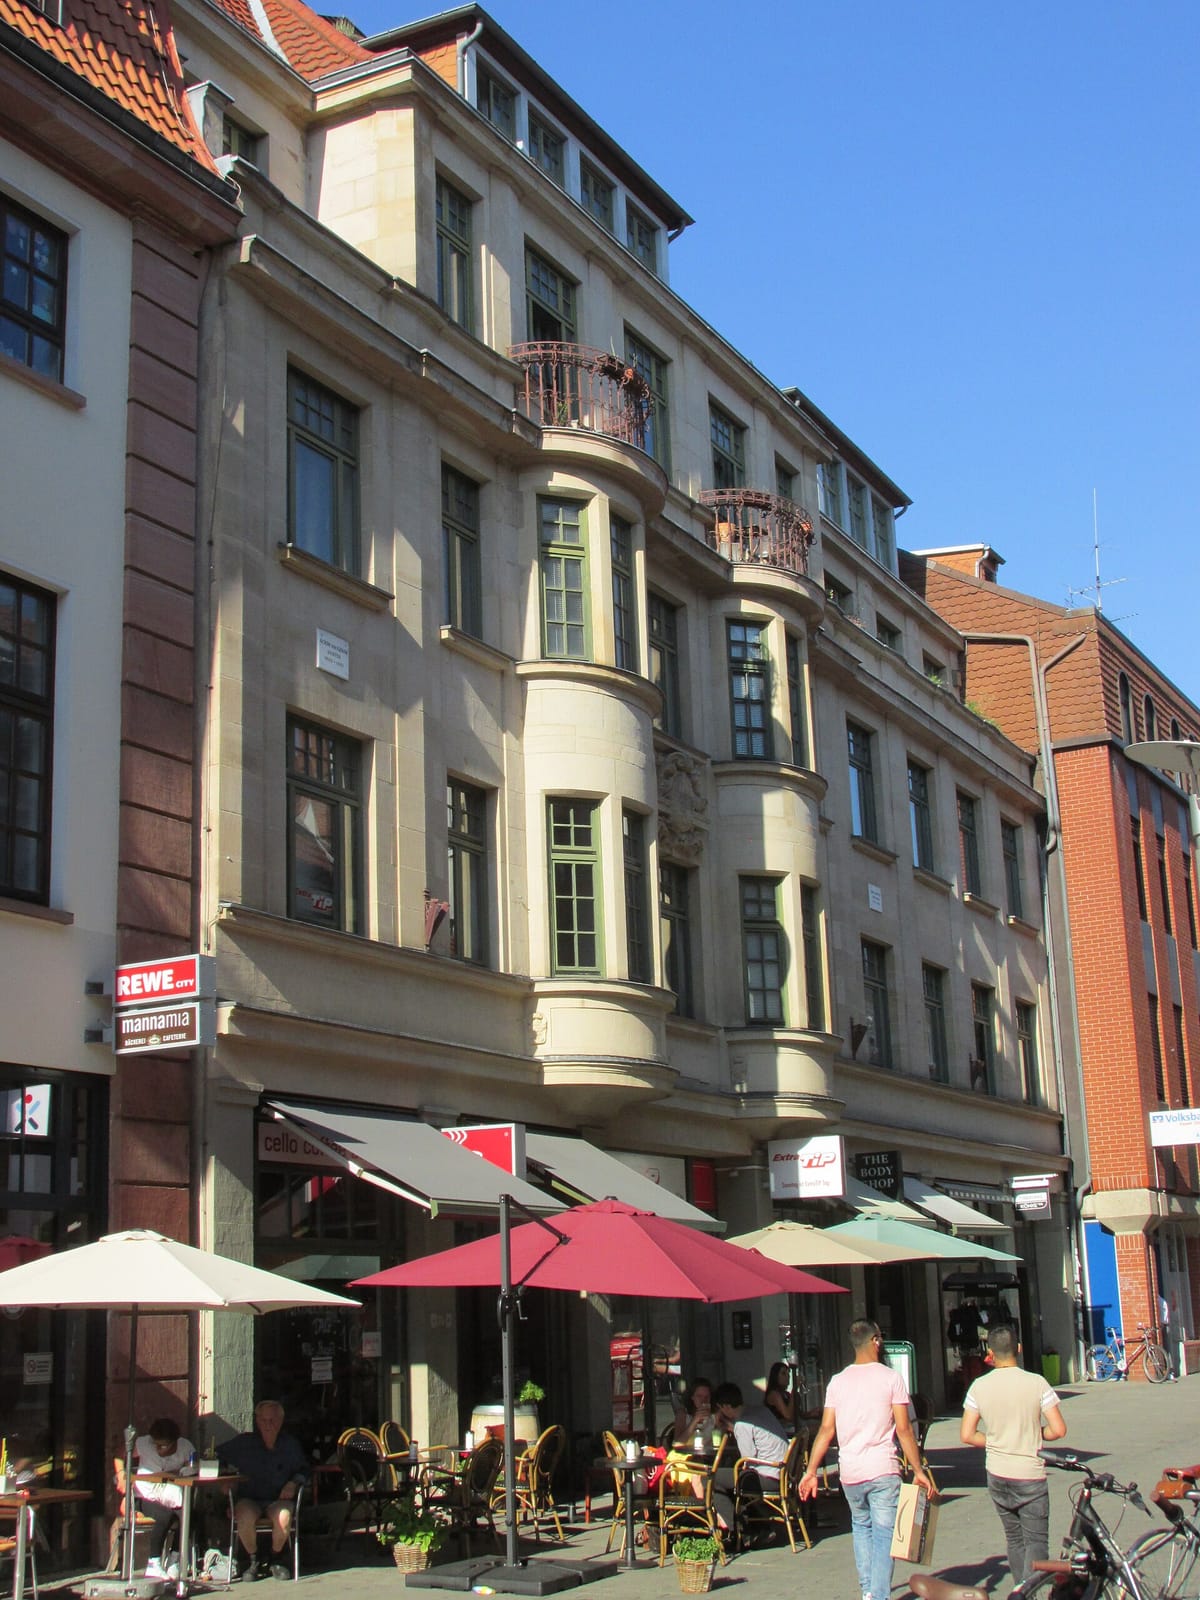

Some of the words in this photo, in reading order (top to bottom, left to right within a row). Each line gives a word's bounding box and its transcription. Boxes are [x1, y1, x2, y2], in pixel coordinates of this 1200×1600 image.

[117, 969, 175, 996] REWE
[176, 979, 194, 988] CITY
[122, 1011, 190, 1034] mannamia
[264, 1132, 298, 1153] cello
[862, 1154, 889, 1165] THE
[860, 1165, 895, 1177] BODY
